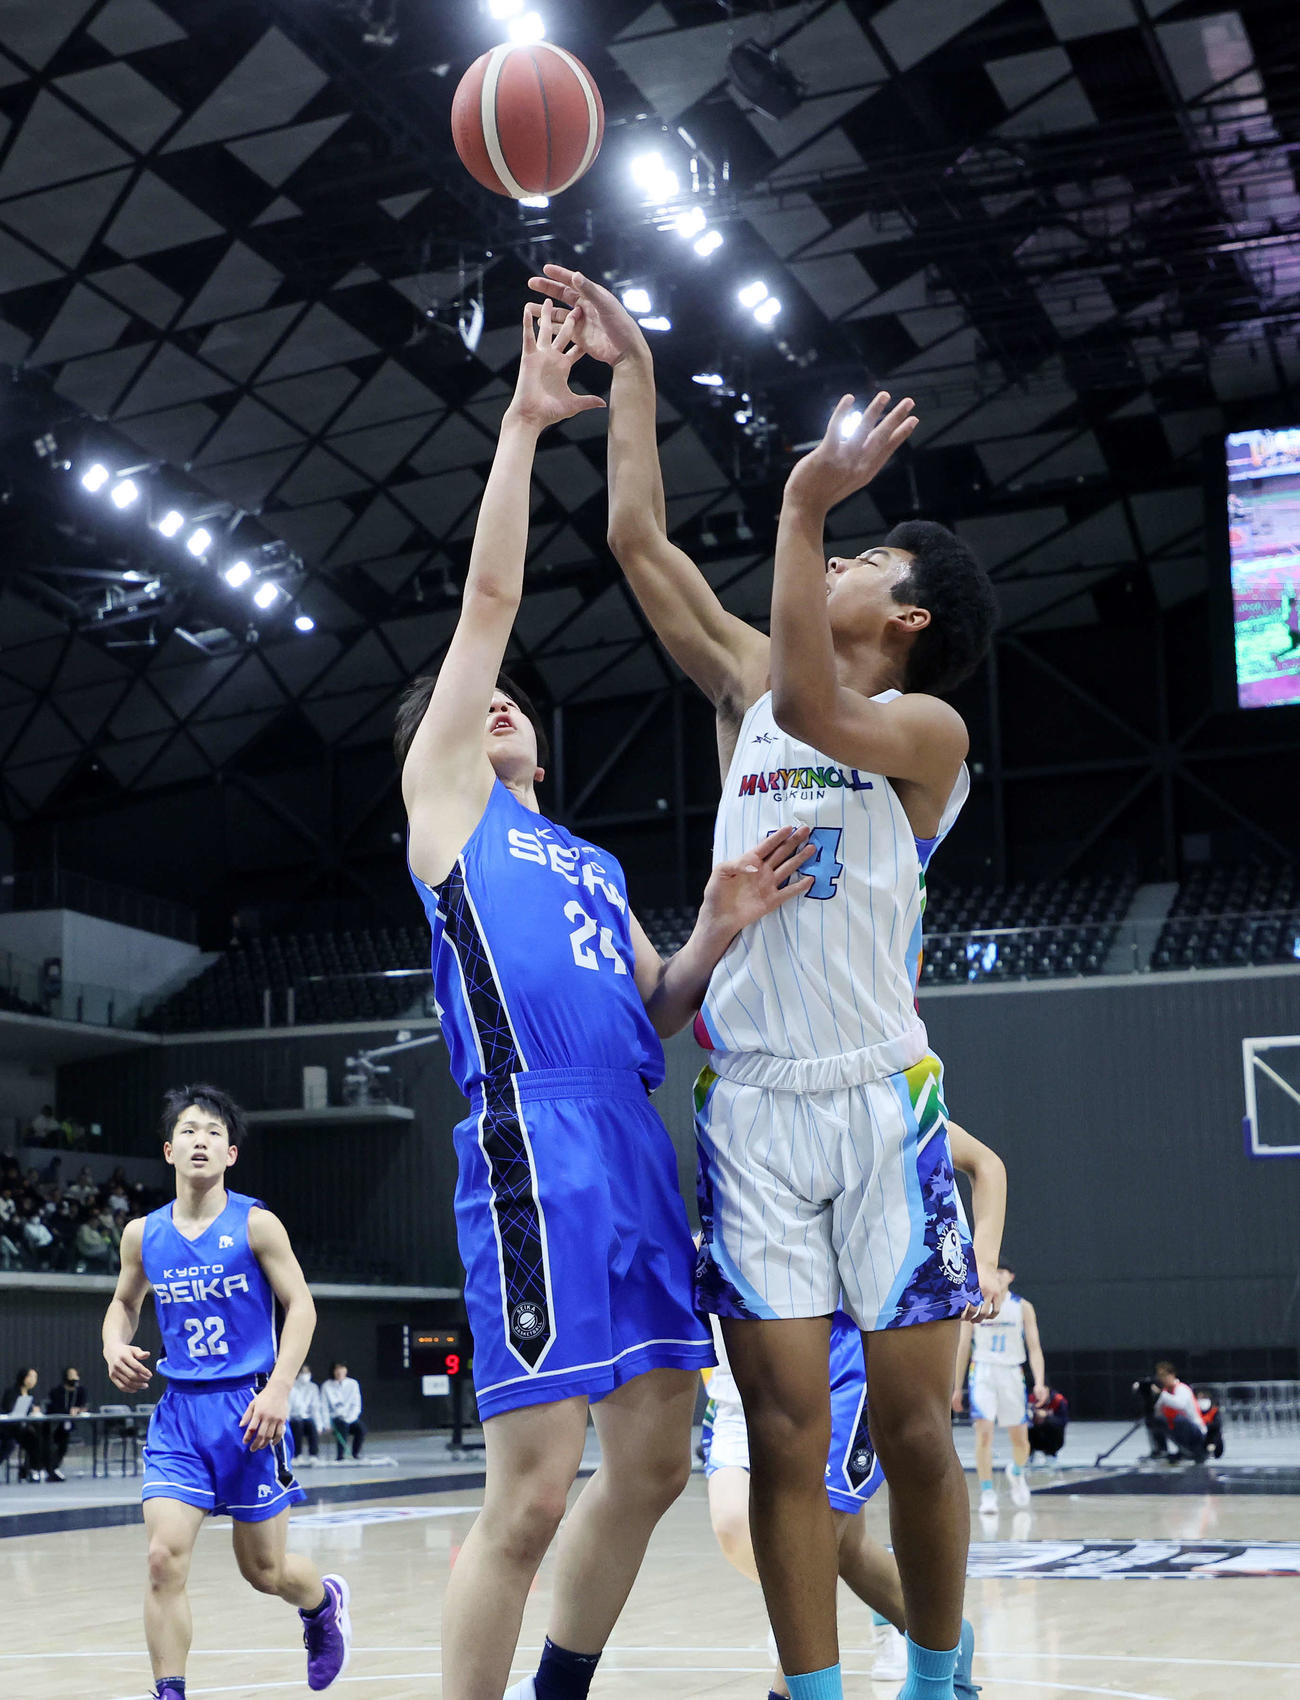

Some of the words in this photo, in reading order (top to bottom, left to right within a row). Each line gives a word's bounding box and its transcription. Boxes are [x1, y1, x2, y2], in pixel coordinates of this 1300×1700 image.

[767, 826, 843, 900] 4
[163, 1264, 224, 1279] KYOTO
[152, 1273, 249, 1304] SEIKA
[183, 1316, 229, 1358] 22
[445, 1354, 460, 1375] 9
